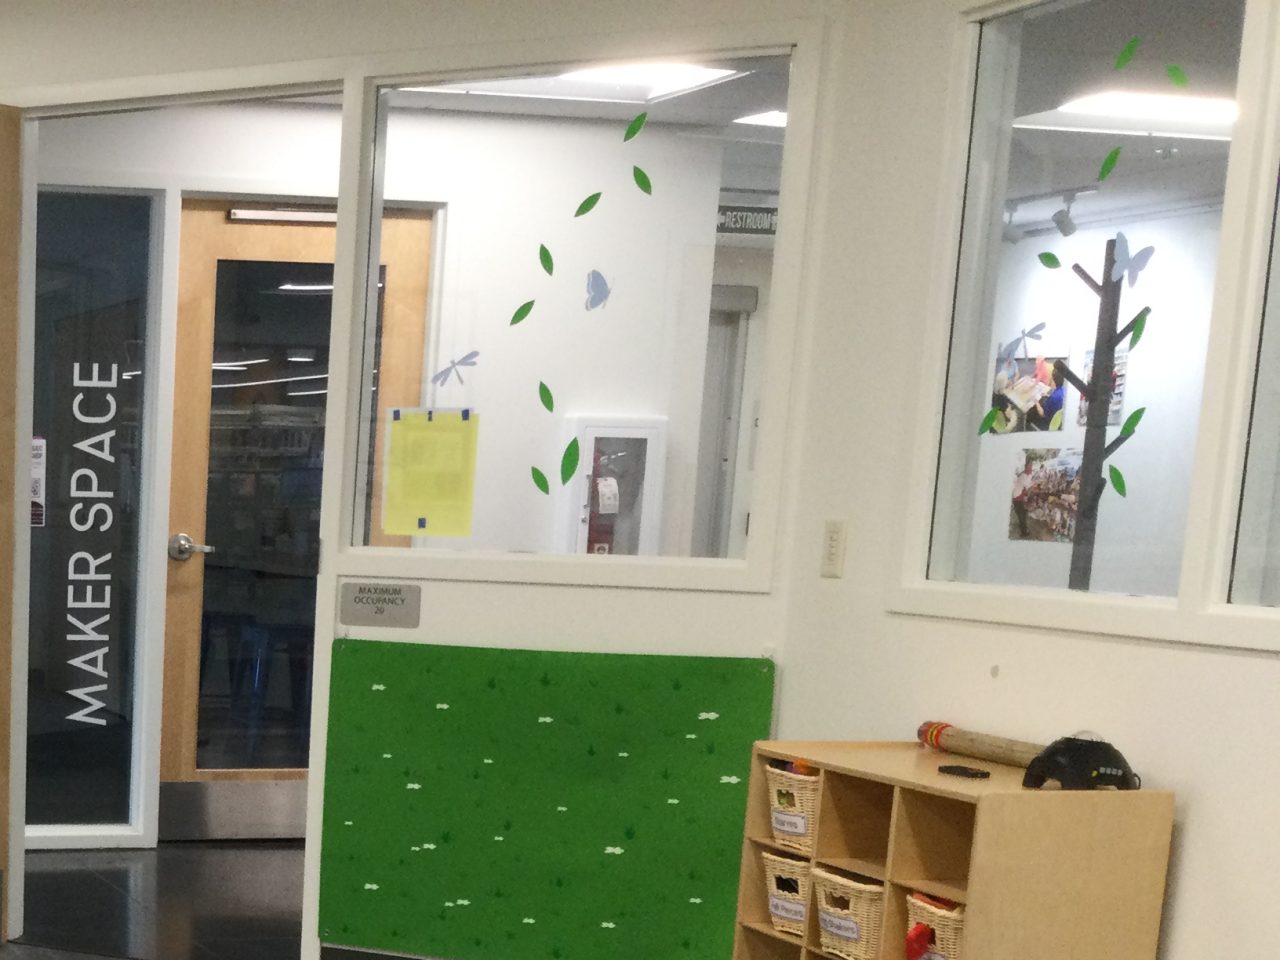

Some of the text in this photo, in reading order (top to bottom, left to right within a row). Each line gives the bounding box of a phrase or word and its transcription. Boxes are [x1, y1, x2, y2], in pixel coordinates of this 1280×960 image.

[725, 211, 771, 230] RESTROOM
[65, 362, 118, 726] MAKER SPACE
[358, 586, 402, 595] MAXIMUM
[353, 595, 406, 605] OCCUPANCY
